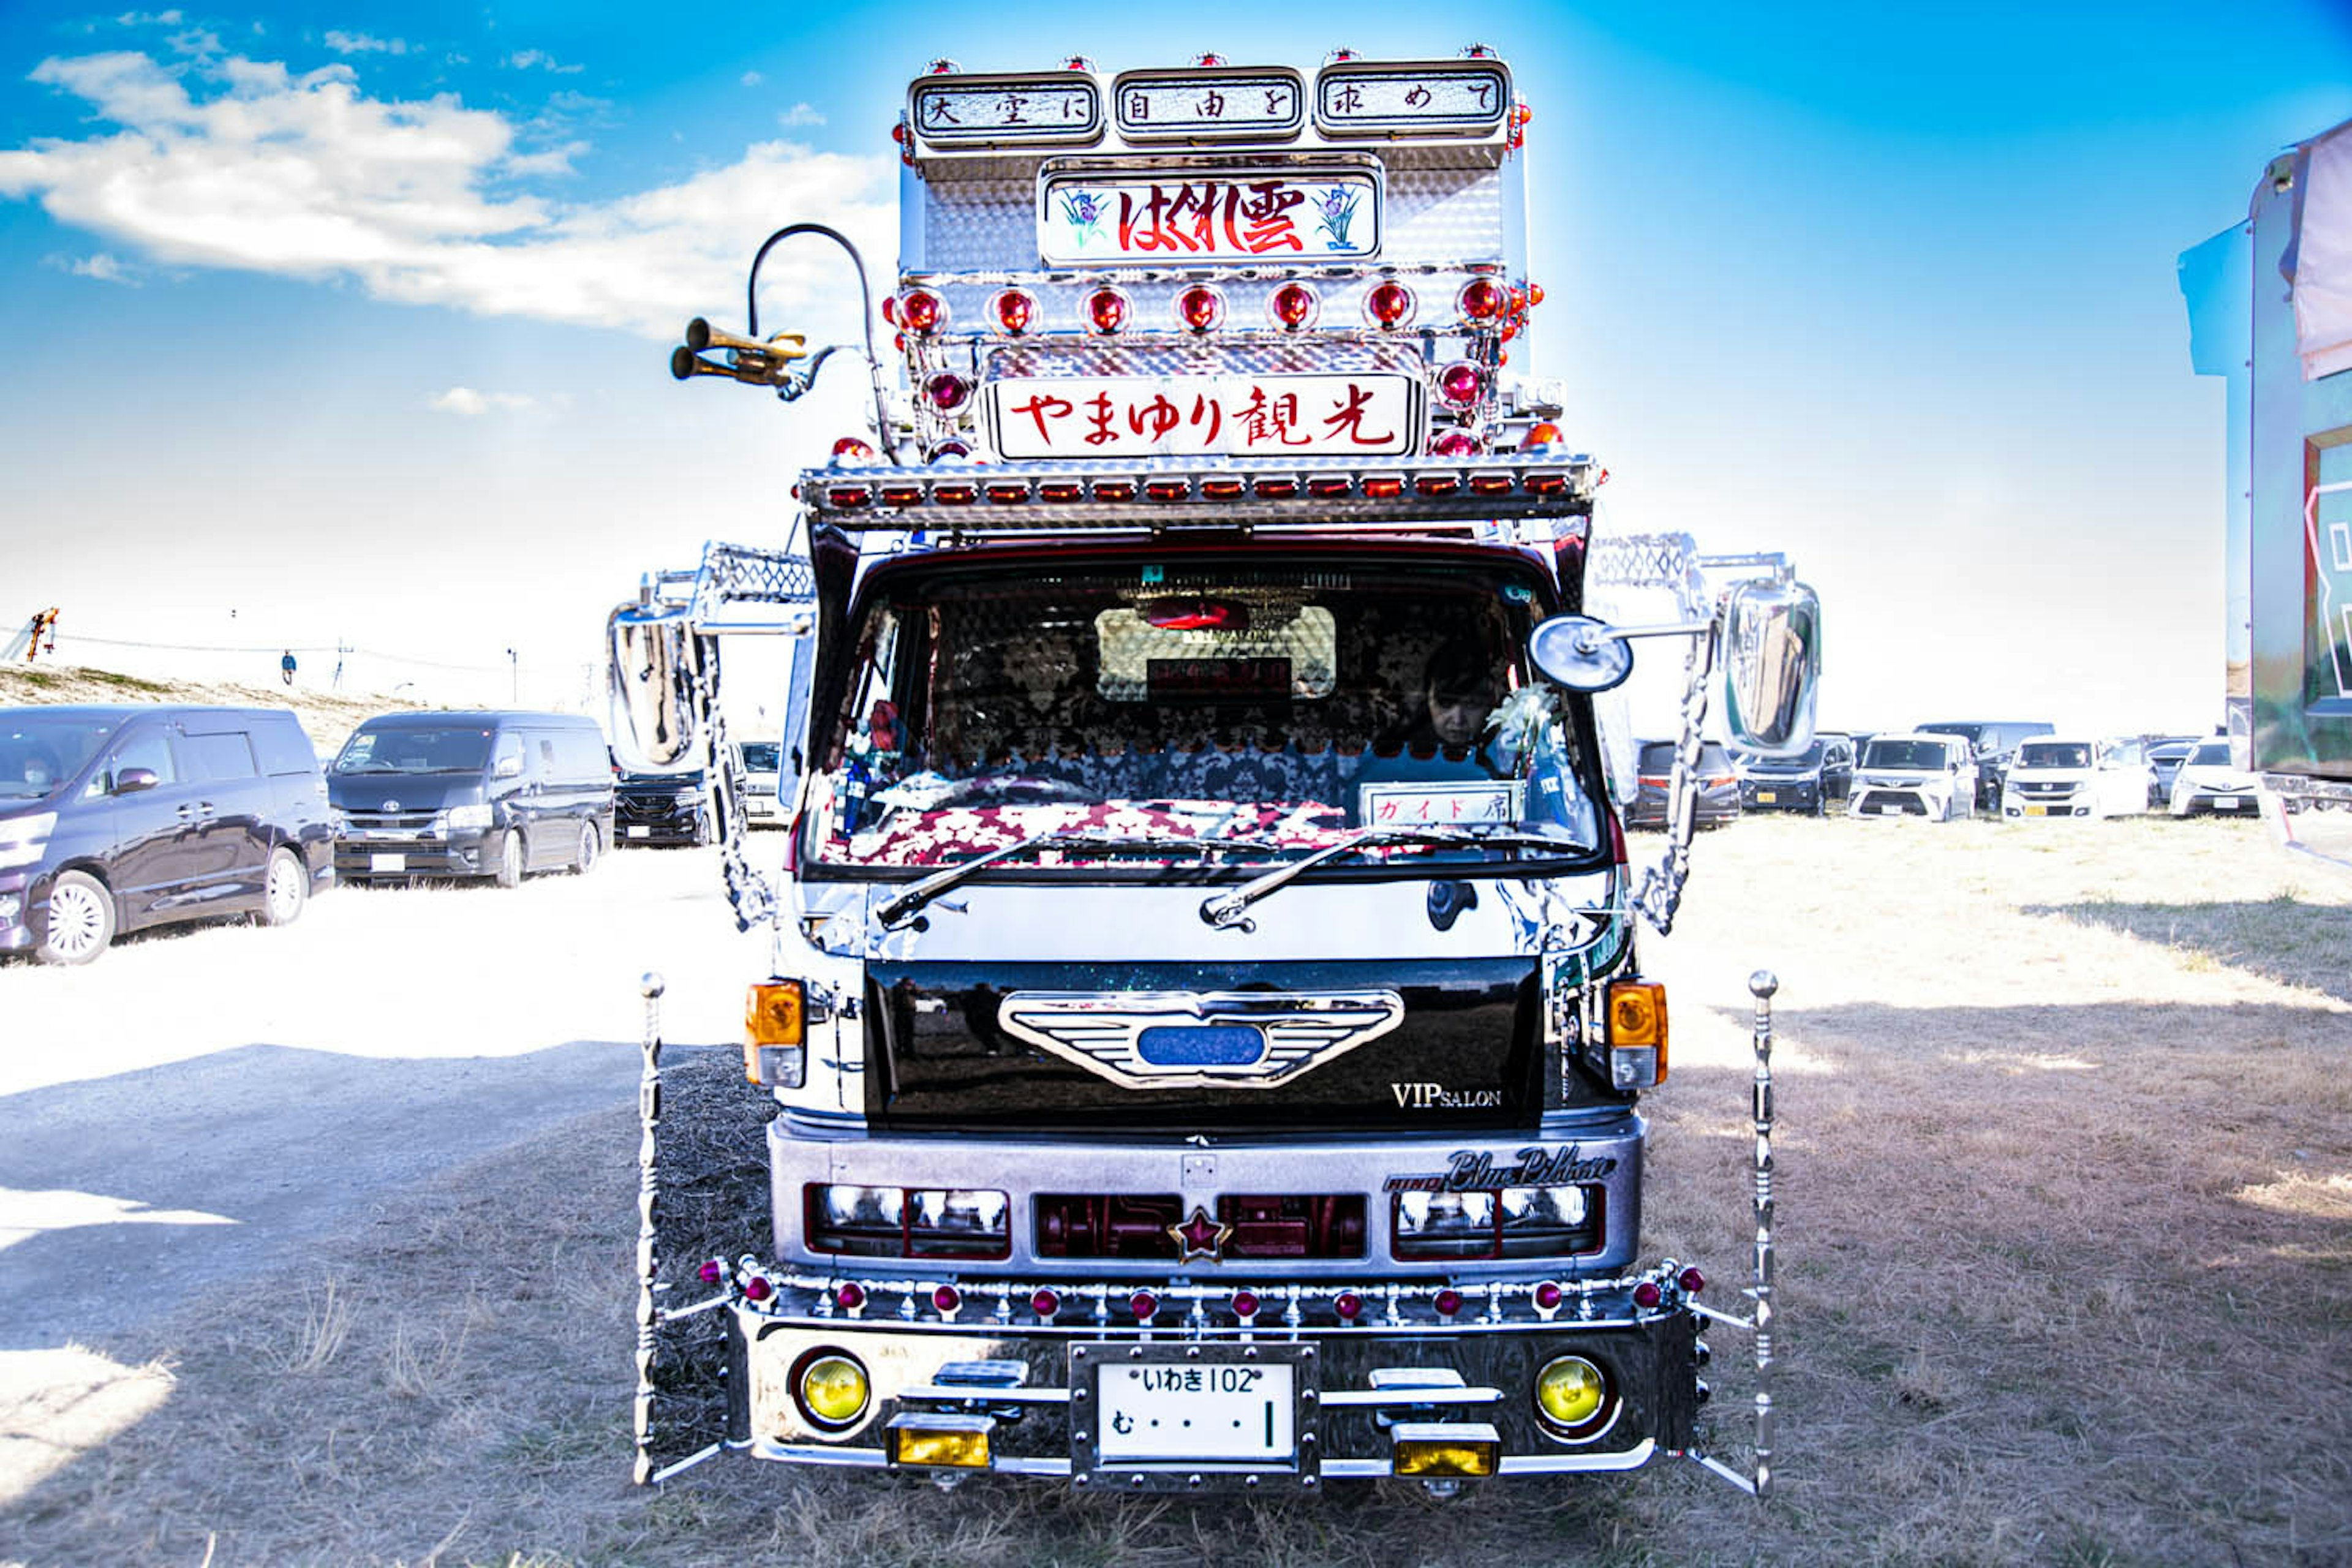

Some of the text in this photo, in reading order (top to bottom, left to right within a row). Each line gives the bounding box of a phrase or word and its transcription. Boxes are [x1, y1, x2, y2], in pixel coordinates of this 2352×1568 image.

[930, 95, 1087, 124] 大空に
[1130, 90, 1287, 119] 自由を
[1334, 84, 1491, 113] 求めて
[1118, 180, 1305, 254] はぐれ雲
[1011, 383, 1395, 447] やまゆり観光
[1379, 795, 1506, 819] ガイド席
